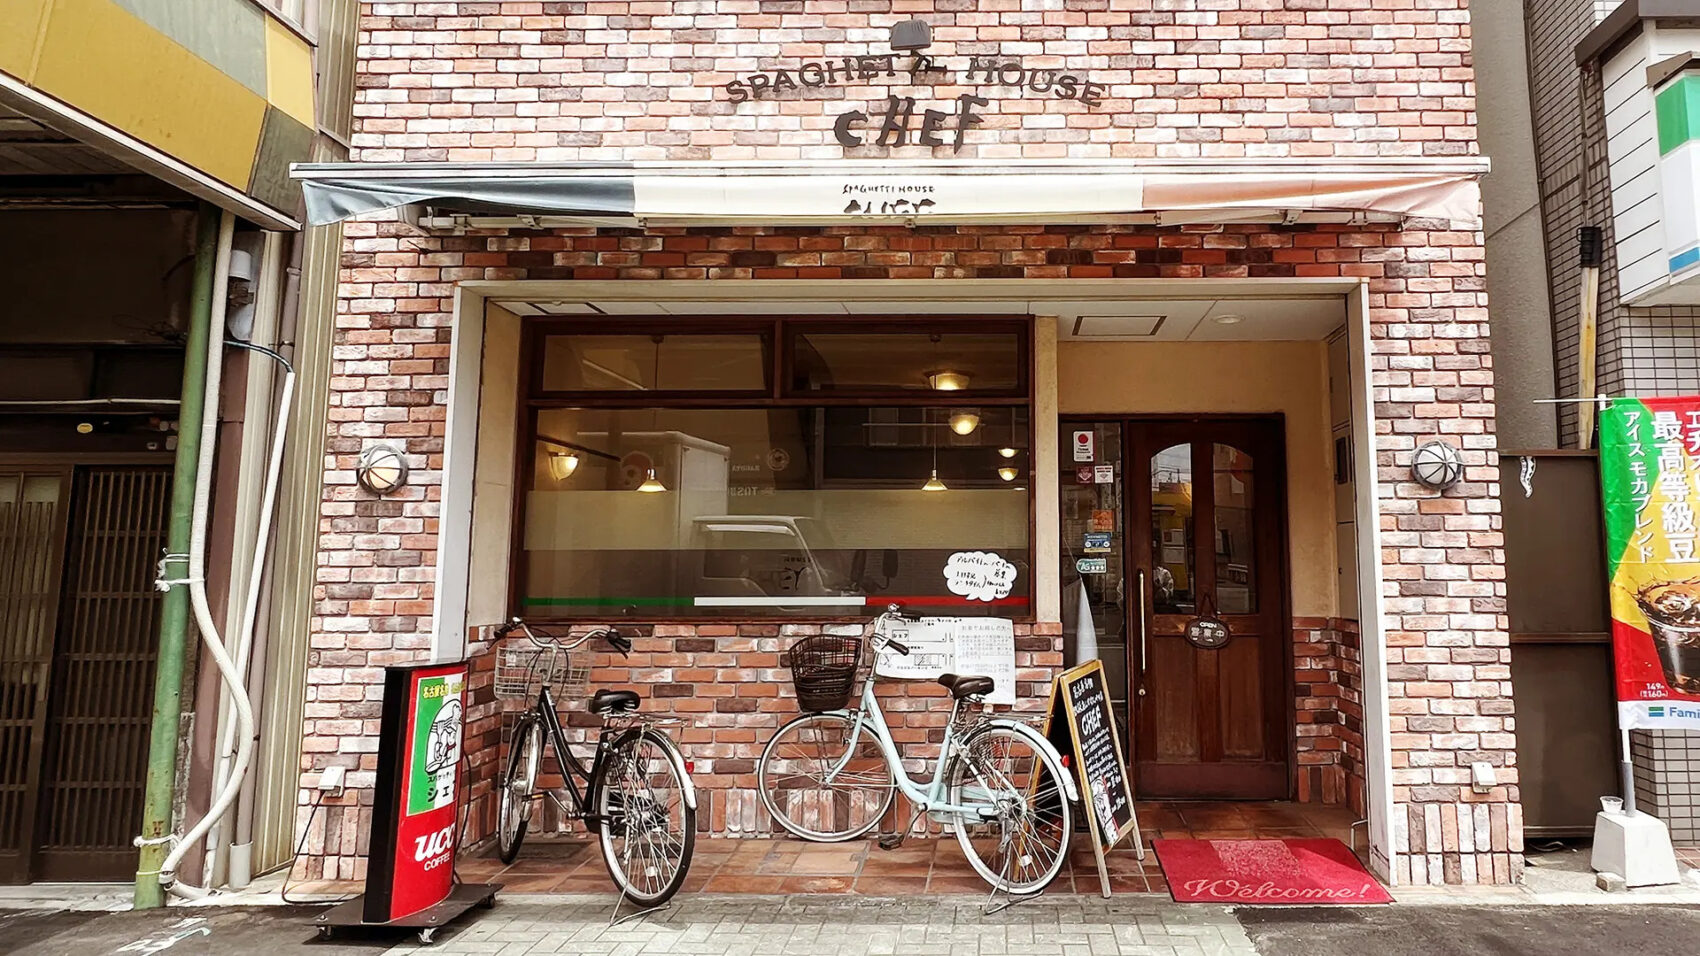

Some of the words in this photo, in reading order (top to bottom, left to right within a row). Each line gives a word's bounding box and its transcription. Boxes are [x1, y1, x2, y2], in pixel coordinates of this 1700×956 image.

[726, 54, 947, 104] SPAGHET
[966, 56, 1106, 107] HOUSE
[834, 94, 989, 154] CHEF
[842, 183, 895, 194] SPAGHETTI
[898, 184, 935, 193] HOUSE
[1651, 411, 1699, 563] 最高等級豆
[1199, 621, 1217, 629] OPEN
[1081, 705, 1105, 736] CHEF
[1669, 706, 1700, 719] Fami
[424, 850, 450, 871] COFFEE
[1183, 879, 1371, 899] Welcome!
